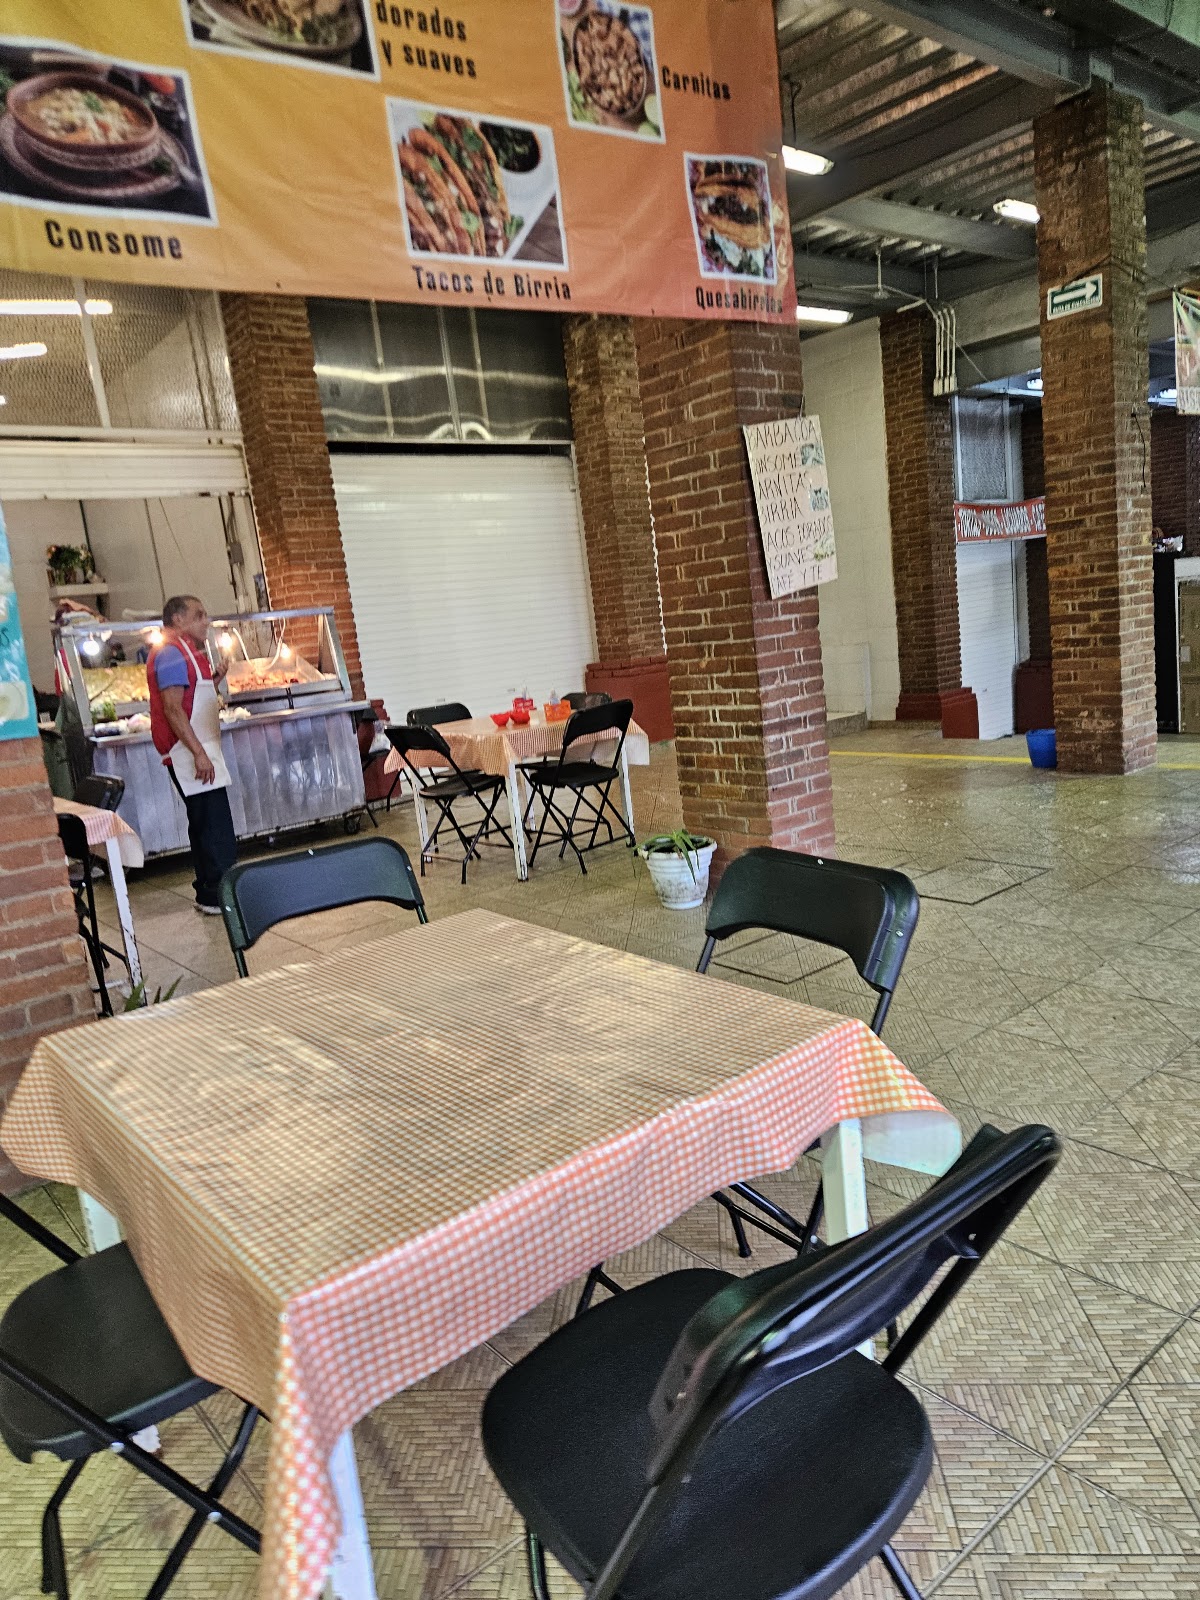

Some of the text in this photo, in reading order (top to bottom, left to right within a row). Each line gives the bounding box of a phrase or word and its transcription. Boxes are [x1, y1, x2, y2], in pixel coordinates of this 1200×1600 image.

[376, 0, 467, 41] dorados
[403, 43, 477, 79] suaves
[661, 65, 731, 100] Carnitas
[44, 218, 183, 259] Consome
[412, 265, 571, 301] Tacos de Birria
[695, 286, 783, 313] Quesabirrias
[746, 419, 820, 452] BARBACOA
